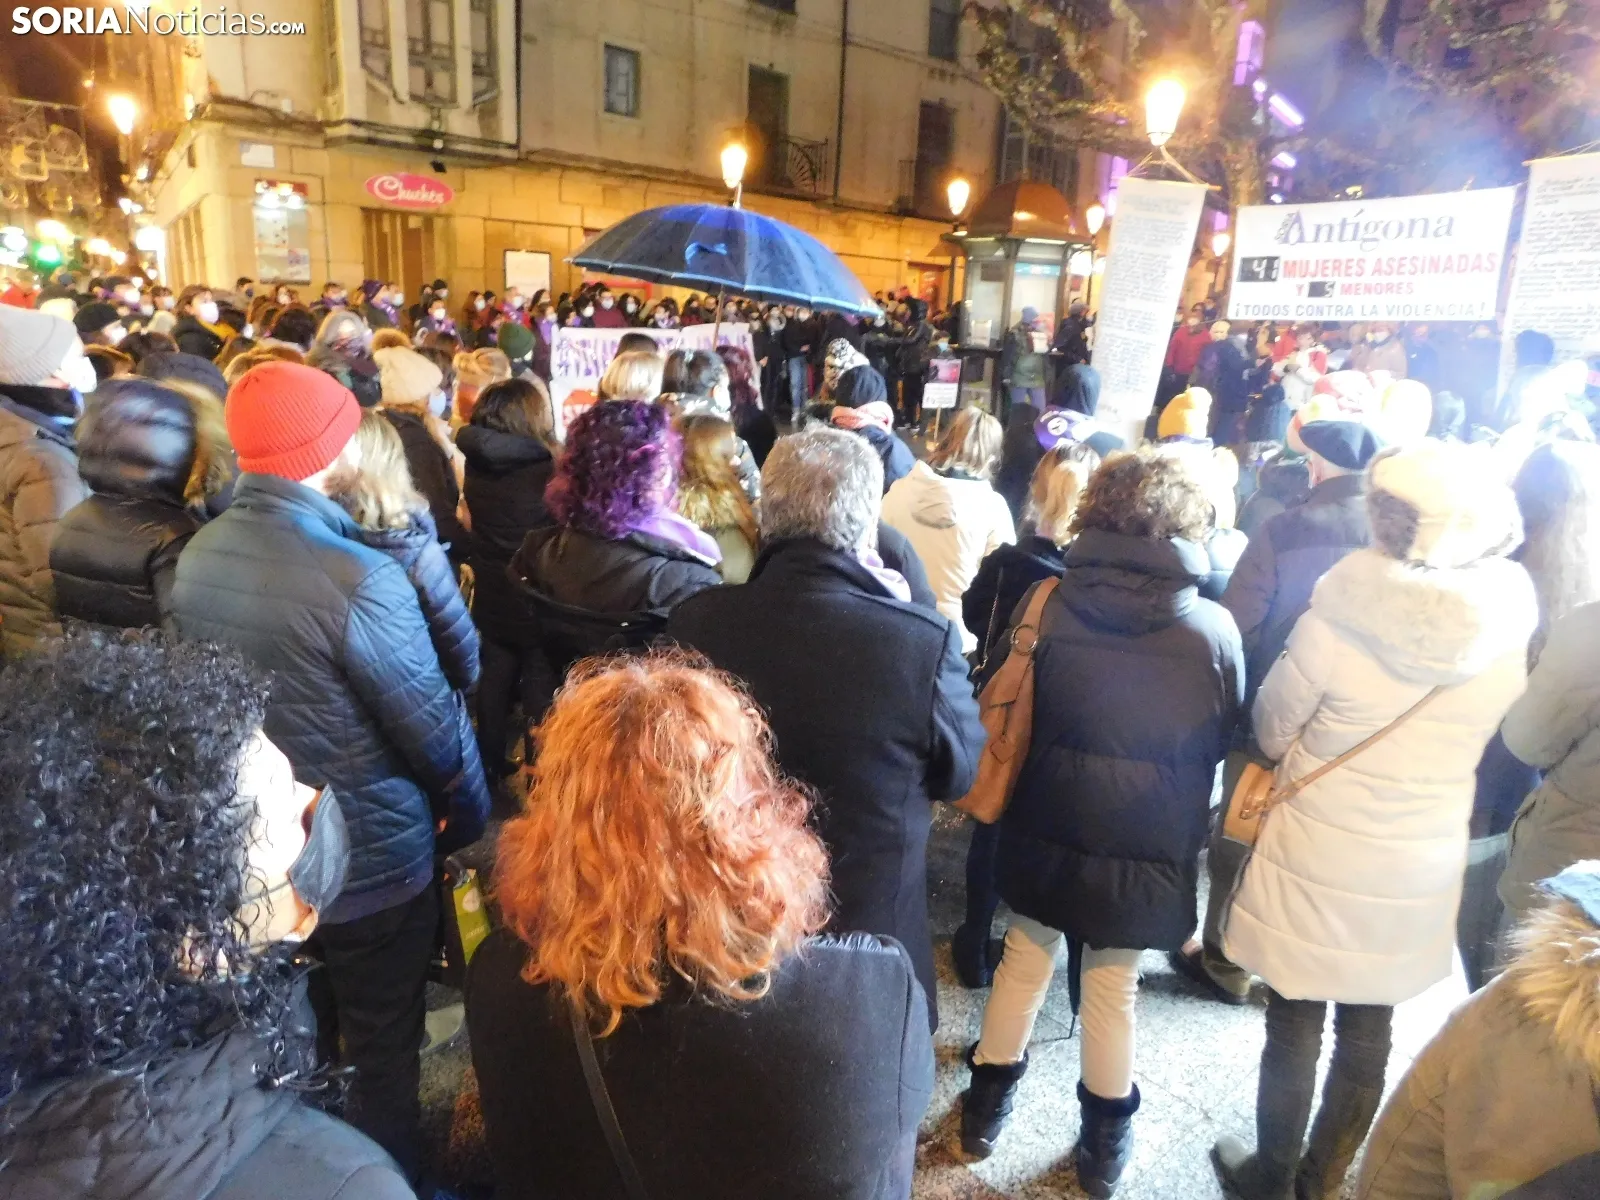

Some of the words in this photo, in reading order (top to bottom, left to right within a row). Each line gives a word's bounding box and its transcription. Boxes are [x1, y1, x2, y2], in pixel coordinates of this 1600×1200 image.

[1276, 208, 1455, 252] Antígona
[1283, 258, 1366, 278] MUJERES
[1296, 284, 1305, 296] Y
[1340, 282, 1414, 296] MENORES
[1235, 303, 1290, 317] ¡TODOS
[1295, 304, 1354, 316] CONTRA
[1360, 304, 1378, 316] LA
[1385, 302, 1486, 318] VIOLENCIA!
